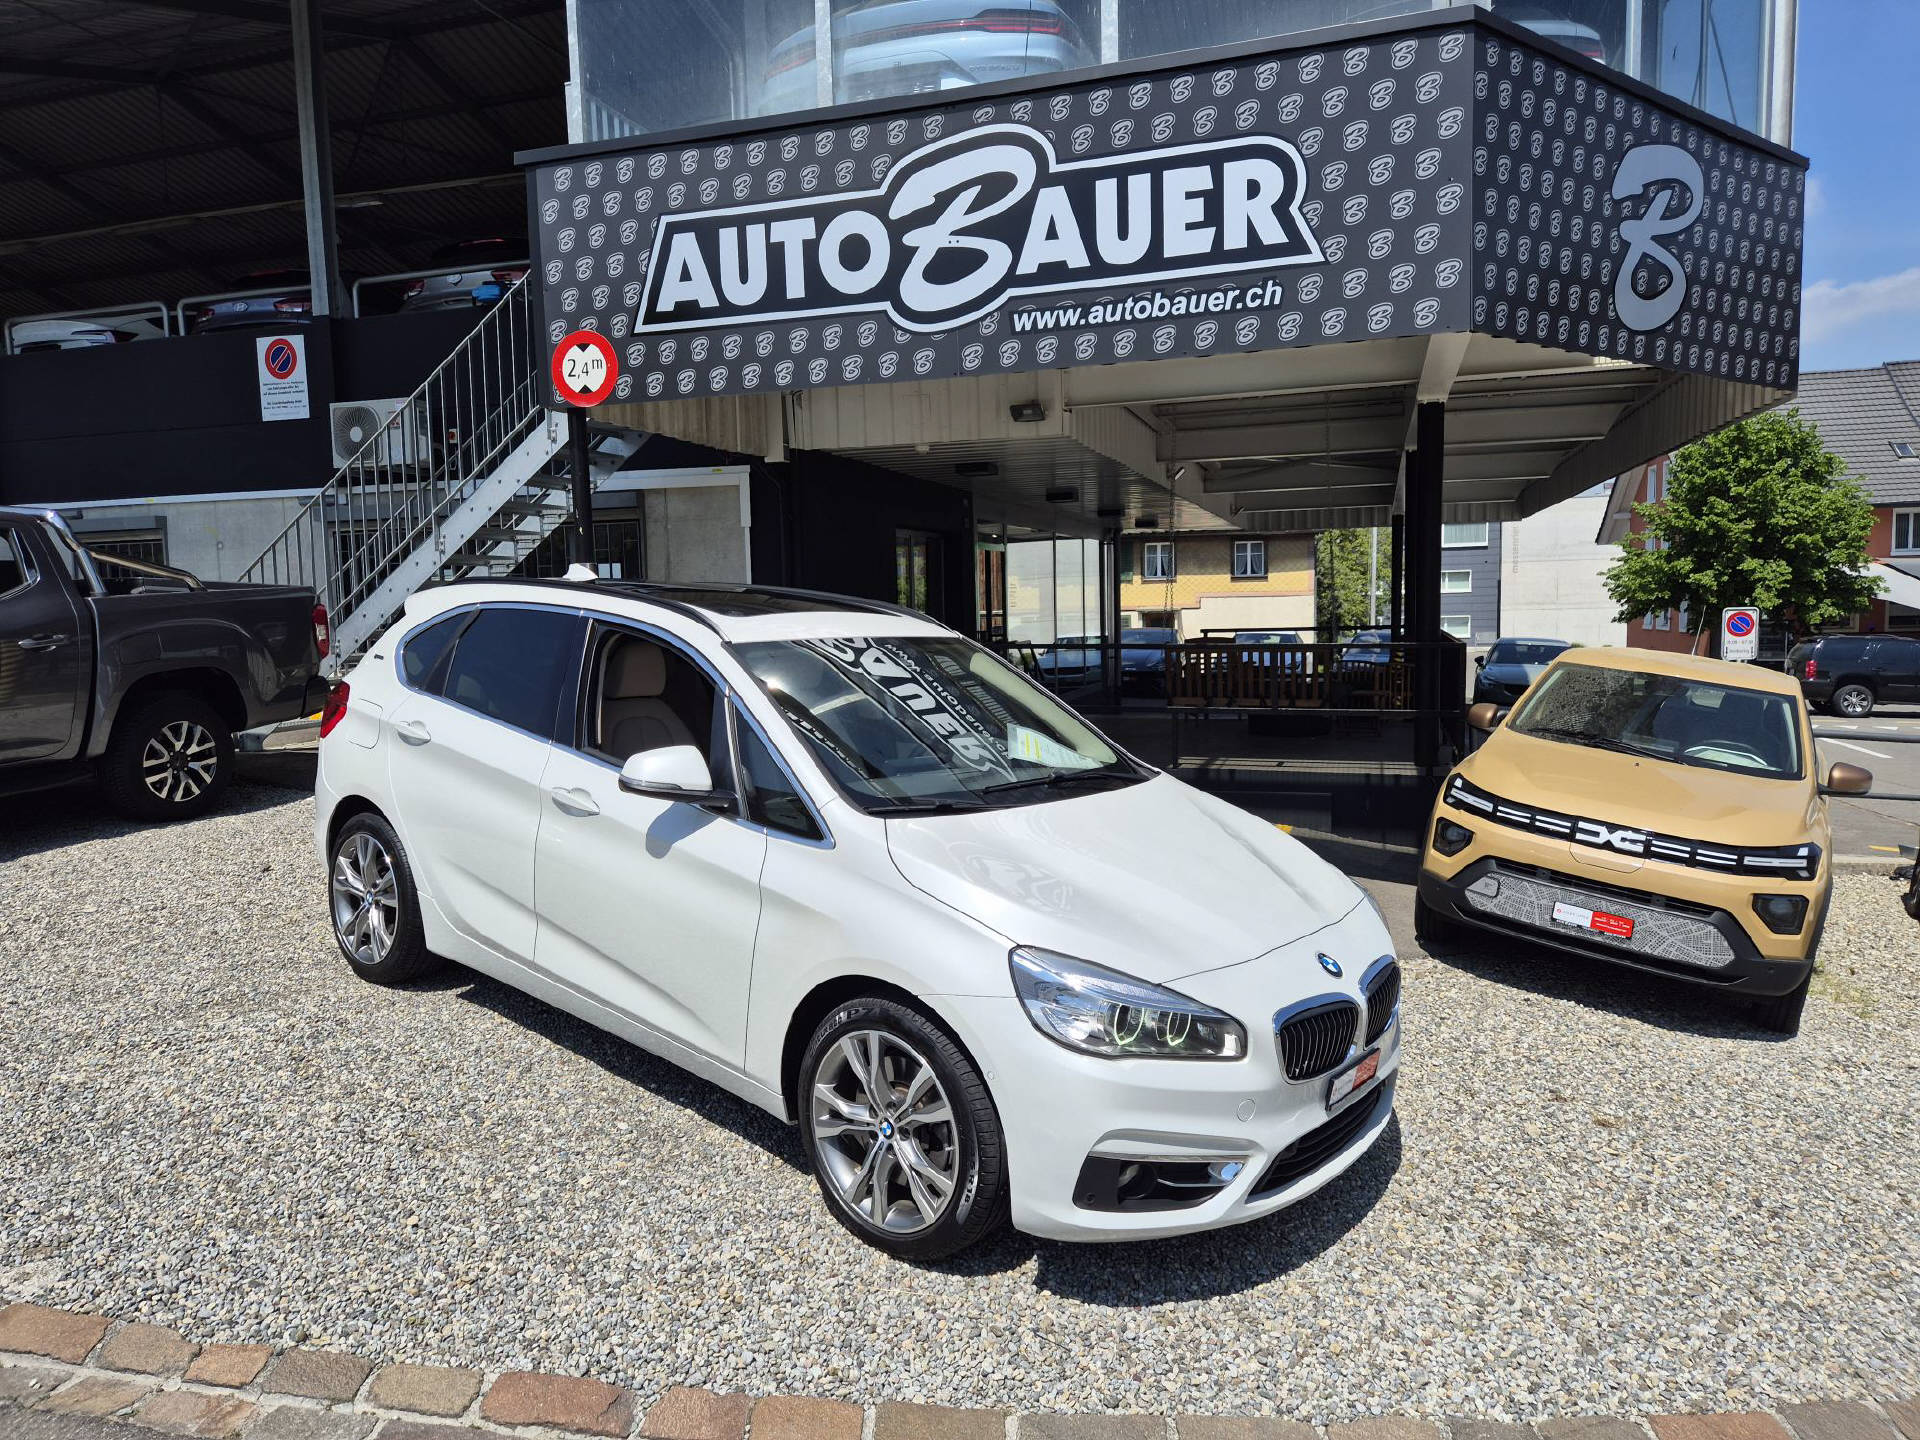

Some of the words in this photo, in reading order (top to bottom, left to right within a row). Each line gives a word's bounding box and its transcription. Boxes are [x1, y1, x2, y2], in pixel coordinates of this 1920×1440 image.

[1392, 41, 1417, 69] B
[1439, 35, 1464, 61] B
[1299, 54, 1323, 83] B
[1344, 48, 1369, 75] B
[1213, 70, 1236, 96] B
[1255, 62, 1279, 90] B
[1416, 72, 1442, 103] B
[1129, 81, 1151, 109] B
[1171, 77, 1194, 102] B
[1323, 87, 1347, 117] B
[1369, 79, 1395, 110] B
[1011, 102, 1032, 121] B
[1050, 96, 1071, 120] B
[1089, 90, 1111, 115] B
[1236, 100, 1259, 129] B
[1279, 94, 1302, 122] B
[888, 121, 907, 144] B
[924, 116, 943, 140] B
[1111, 120, 1133, 146] B
[1152, 113, 1174, 142] B
[1194, 107, 1216, 135] B
[1391, 115, 1416, 144] B
[1438, 107, 1463, 138] B
[816, 132, 834, 155] B
[850, 126, 869, 150] B
[1072, 125, 1093, 152] B
[1299, 128, 1323, 157] B
[1344, 121, 1368, 150] B
[714, 146, 732, 169] B
[747, 142, 766, 166] B
[781, 137, 799, 160] B
[617, 159, 634, 183] B
[649, 154, 666, 178] B
[681, 150, 698, 174] B
[836, 160, 854, 186] B
[872, 155, 891, 182] B
[1369, 155, 1394, 184] B
[1416, 149, 1440, 178] B
[554, 168, 574, 191] B
[585, 163, 602, 187] B
[734, 174, 751, 199] B
[767, 169, 785, 194] B
[801, 165, 819, 191] B
[1322, 162, 1347, 190] B
[604, 192, 621, 215] B
[636, 188, 652, 211] B
[668, 183, 687, 207] B
[700, 179, 718, 203] B
[1437, 183, 1462, 214] B
[541, 200, 559, 223] B
[573, 195, 590, 219] B
[1304, 201, 1322, 227] B
[1344, 195, 1367, 224] B
[1391, 190, 1415, 218] B
[555, 228, 575, 252] B
[589, 224, 605, 248] B
[621, 220, 637, 244] B
[1369, 230, 1393, 258] B
[1415, 224, 1439, 253] B
[1322, 234, 1347, 264] B
[547, 261, 562, 283] B
[576, 257, 593, 280] B
[607, 253, 624, 276] B
[1436, 259, 1462, 287] B
[1298, 274, 1322, 302] B
[1343, 269, 1367, 297] B
[1390, 264, 1415, 292] B
[562, 289, 578, 311] B
[593, 286, 609, 309] B
[624, 283, 641, 306] B
[1012, 279, 1284, 333] www.autobauer.ch
[1322, 308, 1346, 335] B
[1368, 303, 1393, 332] B
[1414, 298, 1439, 327] B
[551, 320, 567, 343] B
[611, 314, 628, 337] B
[823, 325, 841, 349] B
[858, 322, 876, 346] B
[1195, 321, 1217, 348] B
[1236, 317, 1259, 344] B
[1278, 313, 1302, 340] B
[692, 337, 708, 360] B
[723, 335, 741, 358] B
[757, 332, 774, 356] B
[790, 329, 808, 353] B
[1037, 337, 1057, 362] B
[1075, 334, 1096, 359] B
[1114, 330, 1135, 356] B
[1154, 326, 1175, 352] B
[628, 344, 645, 366] B
[659, 341, 675, 363] B
[879, 352, 898, 377] B
[914, 349, 935, 373] B
[962, 344, 983, 369] B
[1000, 341, 1020, 366] B
[710, 367, 727, 390] B
[743, 364, 760, 387] B
[775, 361, 793, 384] B
[809, 359, 827, 382] B
[843, 356, 862, 380] B
[616, 375, 631, 398] B
[647, 373, 663, 395] B
[678, 370, 695, 392] B
